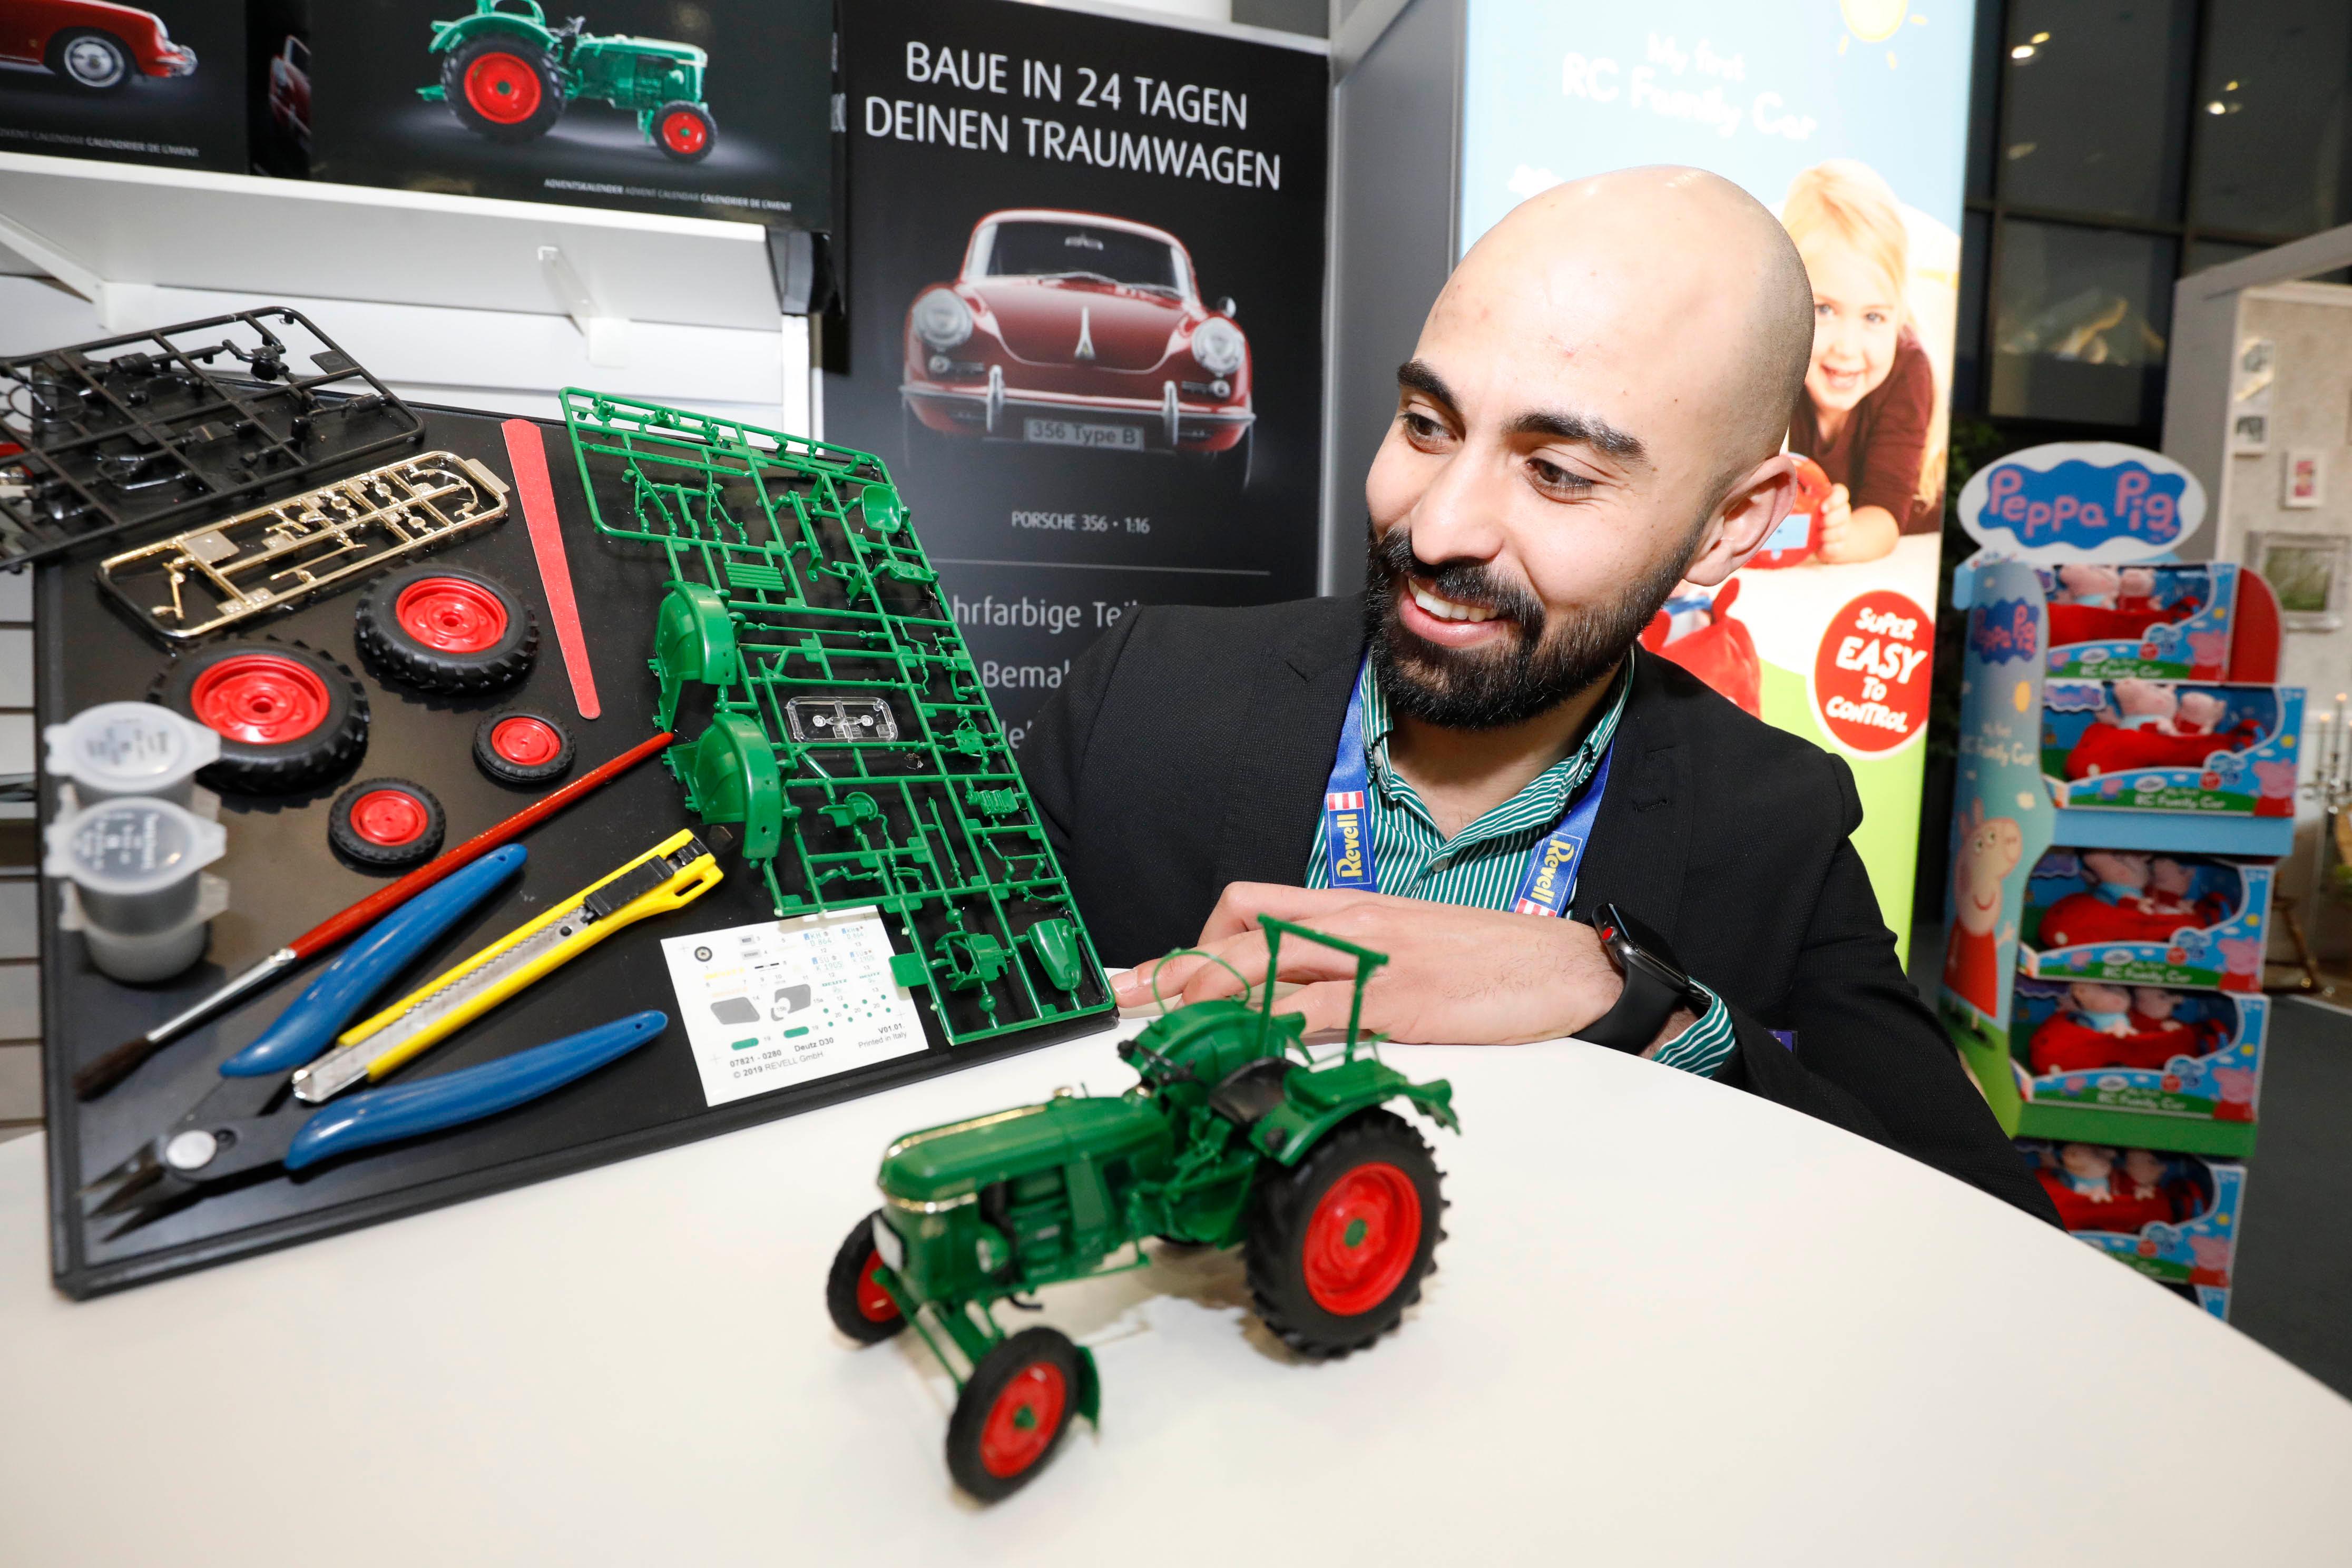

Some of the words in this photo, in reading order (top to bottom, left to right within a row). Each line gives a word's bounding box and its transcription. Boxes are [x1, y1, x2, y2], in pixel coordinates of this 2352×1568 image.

[1648, 31, 1689, 75] My
[906, 41, 1007, 94] BAUE
[1023, 59, 1061, 102] IN
[1076, 67, 1121, 110] 24
[1134, 76, 1247, 130] TAGEN
[1562, 52, 1619, 102] RC
[1630, 64, 1742, 138] Family
[1752, 90, 1817, 140] Car
[865, 96, 1008, 153] DEINEN
[1022, 117, 1280, 190] TRAUMWAGEN
[544, 178, 624, 194] ADVENTSKALENDER
[750, 198, 760, 209] DE
[1032, 423, 1066, 439] 356
[1074, 425, 1116, 444] Type
[1123, 428, 1136, 444] B
[1012, 511, 1076, 531] PORSCHE
[1082, 514, 1108, 532] 356
[1124, 517, 1150, 534] 1:16
[1989, 468, 2108, 538] Peppa
[2115, 471, 2179, 538] Pig
[953, 595, 1081, 634] hrfarbige
[1855, 607, 1918, 640] SUPER
[1836, 636, 1928, 684] EASY
[1826, 696, 1909, 733] CONTROL
[1336, 814, 1363, 878] Revell
[1530, 836, 1575, 904] Revell
[730, 1056, 754, 1068] 07821
[762, 1050, 782, 1060] 0280
[794, 1042, 817, 1052] Deutz
[818, 1037, 834, 1046] D30
[858, 1038, 884, 1048] Printed
[893, 1031, 907, 1040] Italy
[743, 1066, 763, 1077] 2019
[765, 1059, 798, 1072] REVELL
[799, 1052, 824, 1063] GmbH
